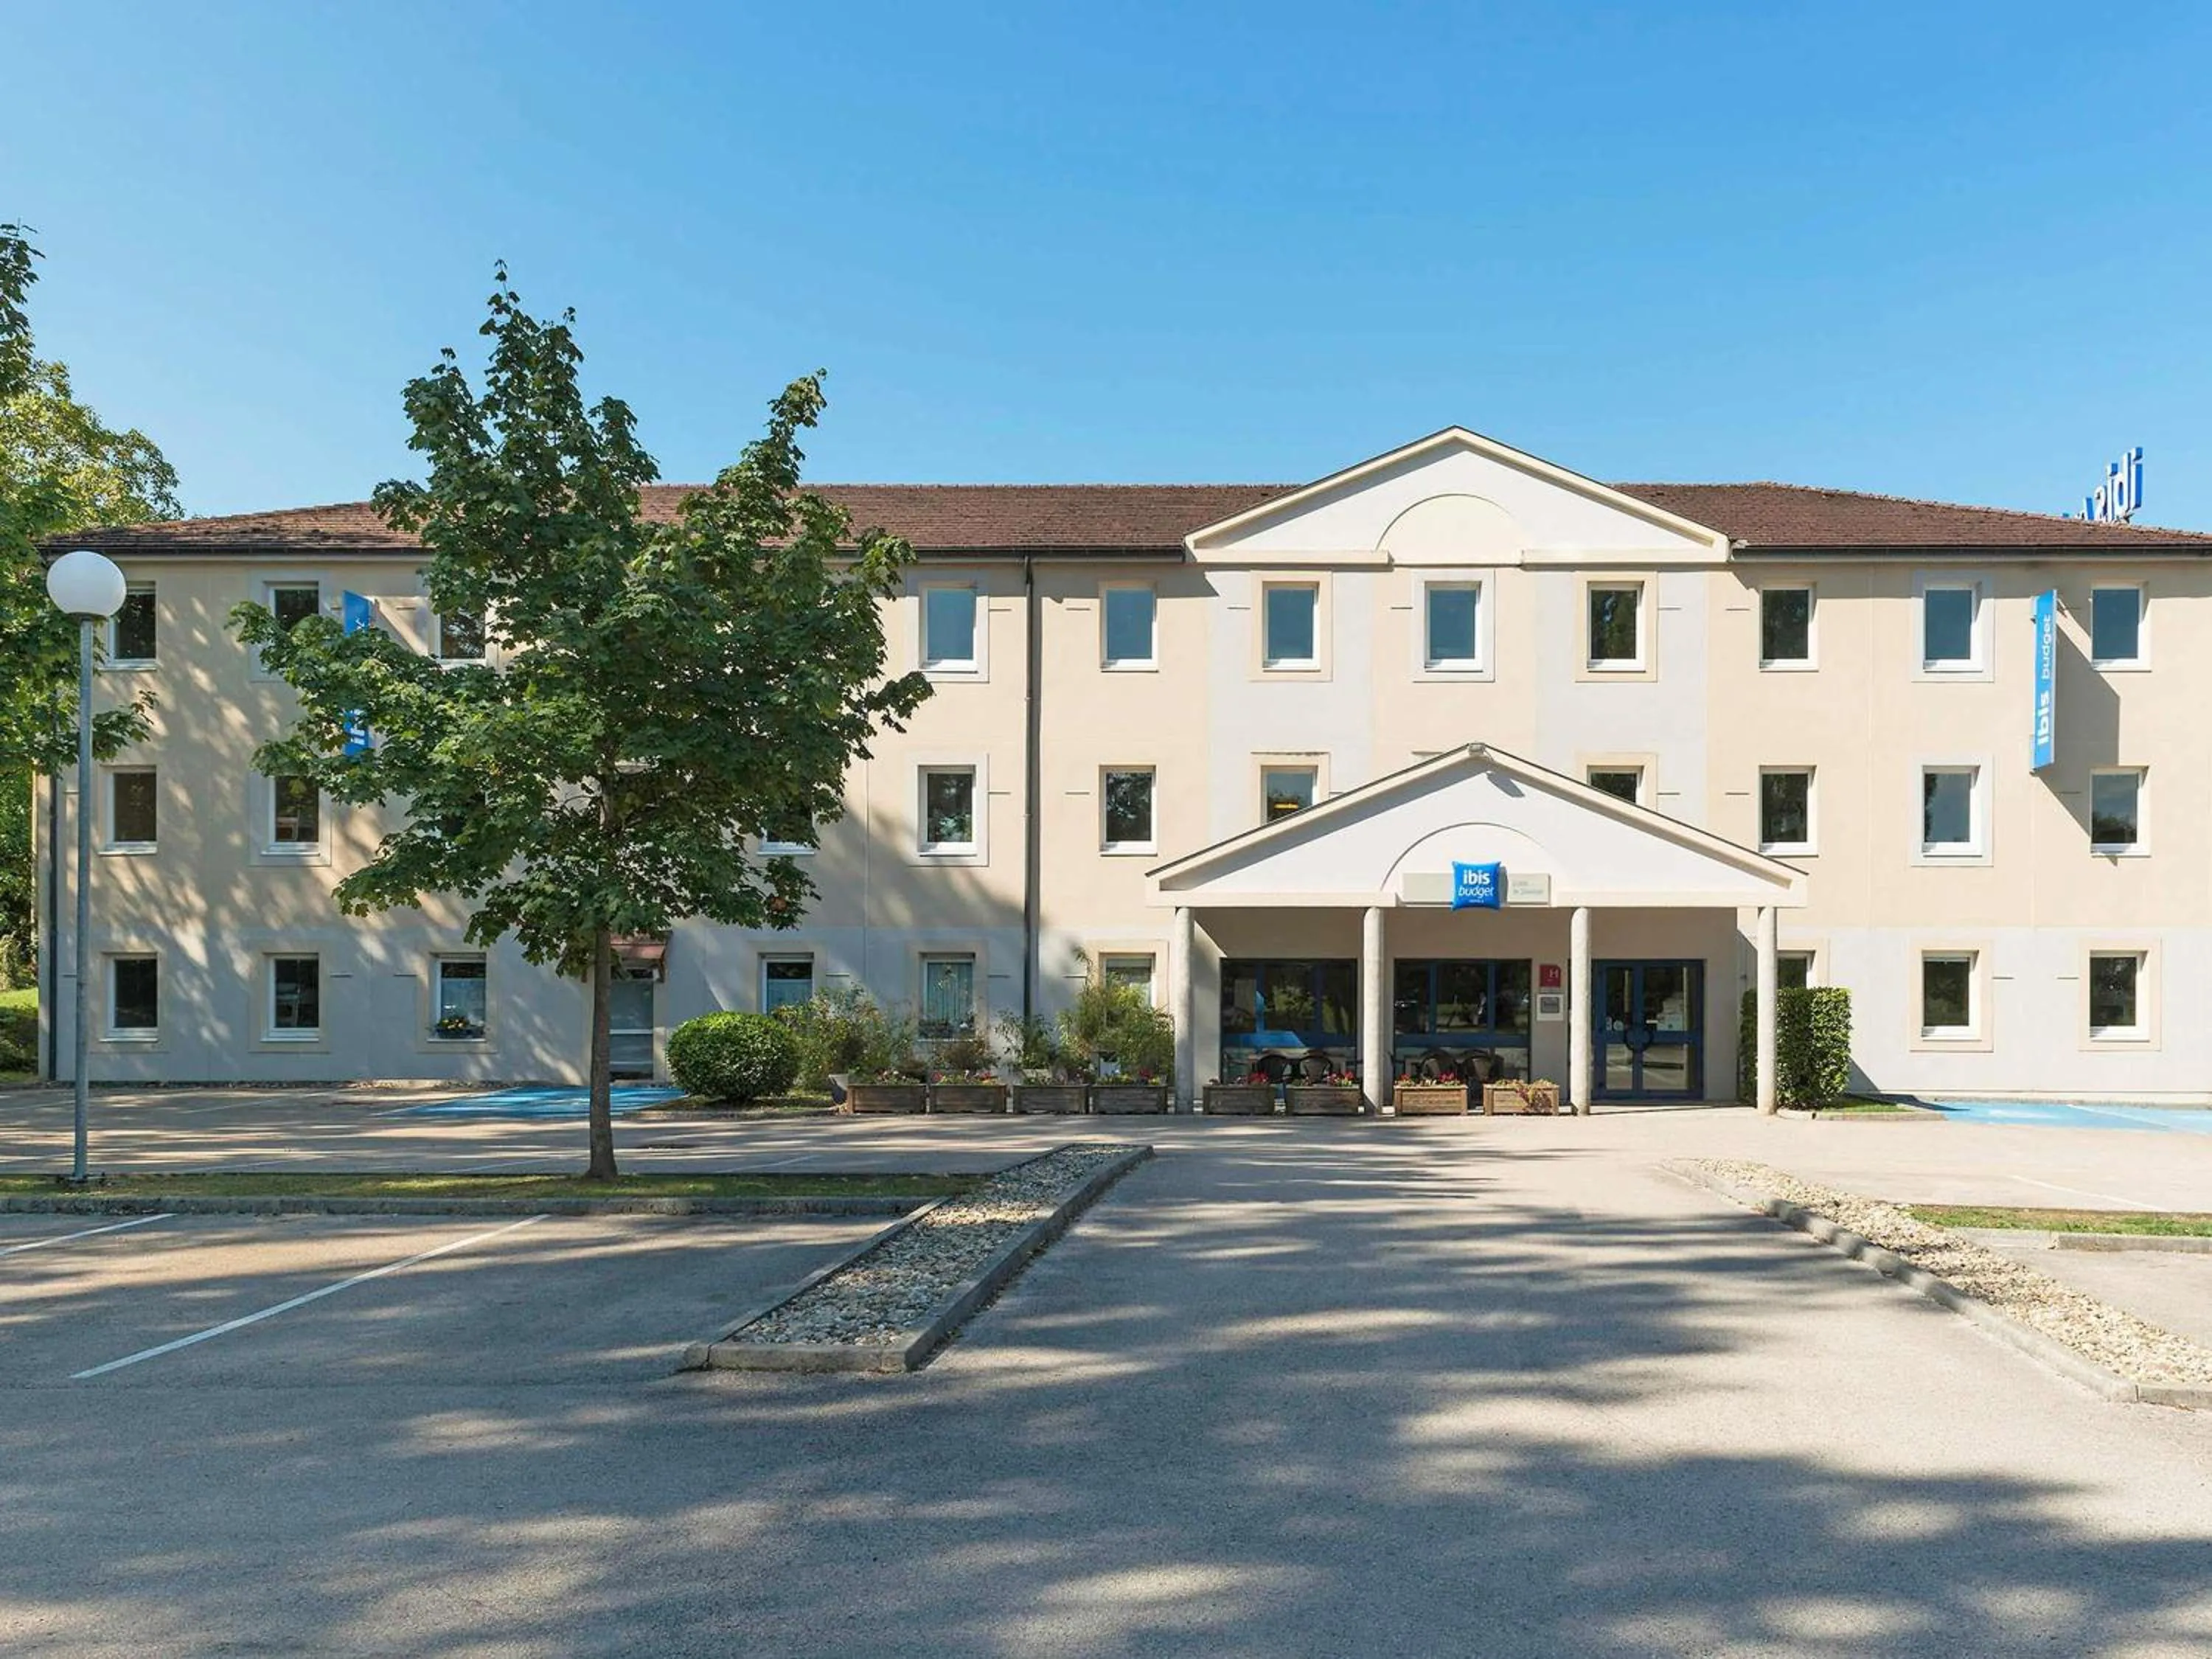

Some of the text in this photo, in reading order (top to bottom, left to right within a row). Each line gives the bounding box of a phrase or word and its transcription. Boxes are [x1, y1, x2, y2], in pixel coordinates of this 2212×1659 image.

[2037, 613, 2051, 745] ibis budget
[1463, 870, 1490, 885] ibis
[1458, 886, 1495, 898] budget
